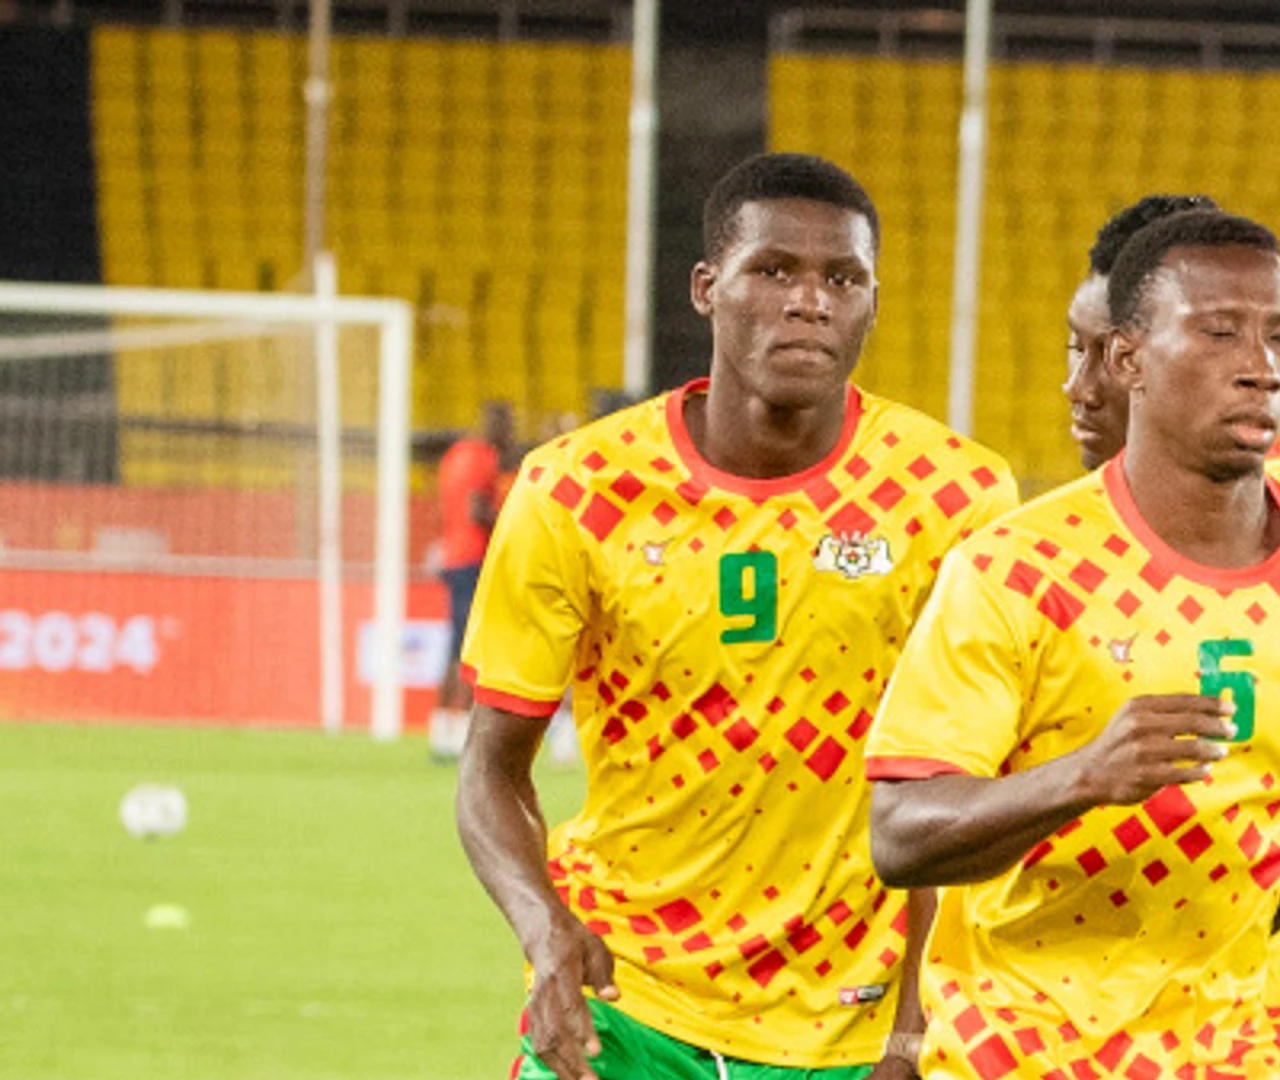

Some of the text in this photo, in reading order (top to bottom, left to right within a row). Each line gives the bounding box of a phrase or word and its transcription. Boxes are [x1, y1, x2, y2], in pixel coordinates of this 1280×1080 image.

[0, 609, 161, 676] 2024
[719, 550, 777, 644] 9
[1199, 639, 1254, 742] 6
